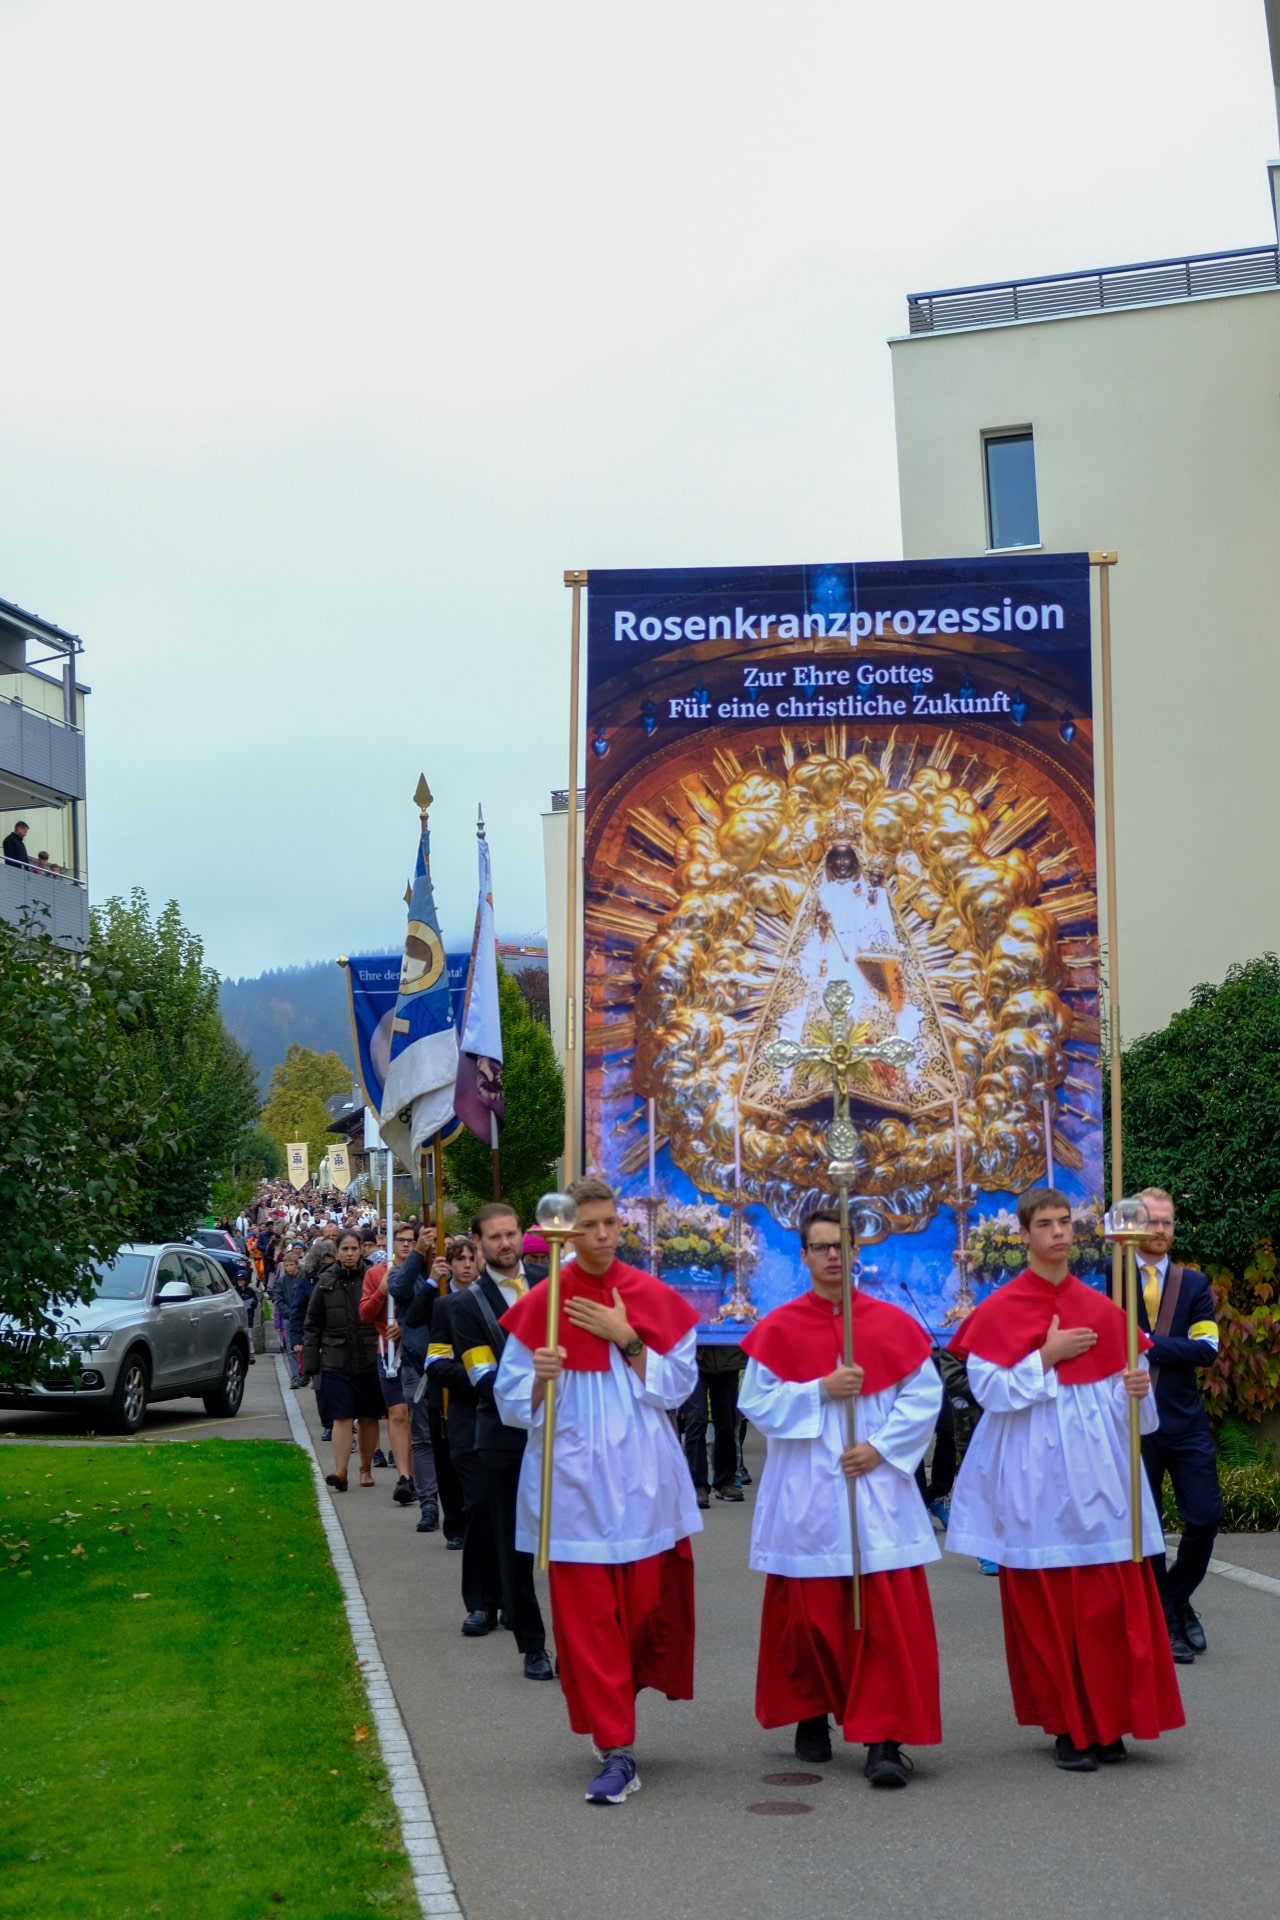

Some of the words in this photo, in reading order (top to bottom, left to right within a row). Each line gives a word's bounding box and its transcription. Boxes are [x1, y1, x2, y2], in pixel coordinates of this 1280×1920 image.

[613, 597, 1065, 646] Rosenkranzprozession
[743, 667, 786, 687] Zur
[792, 665, 850, 687] Ehre
[856, 664, 934, 685] Gottes
[668, 698, 714, 719] Für
[717, 698, 770, 719] eine
[775, 696, 907, 719] christliche
[912, 690, 1011, 716] Zukunft
[358, 969, 382, 981] Ehre
